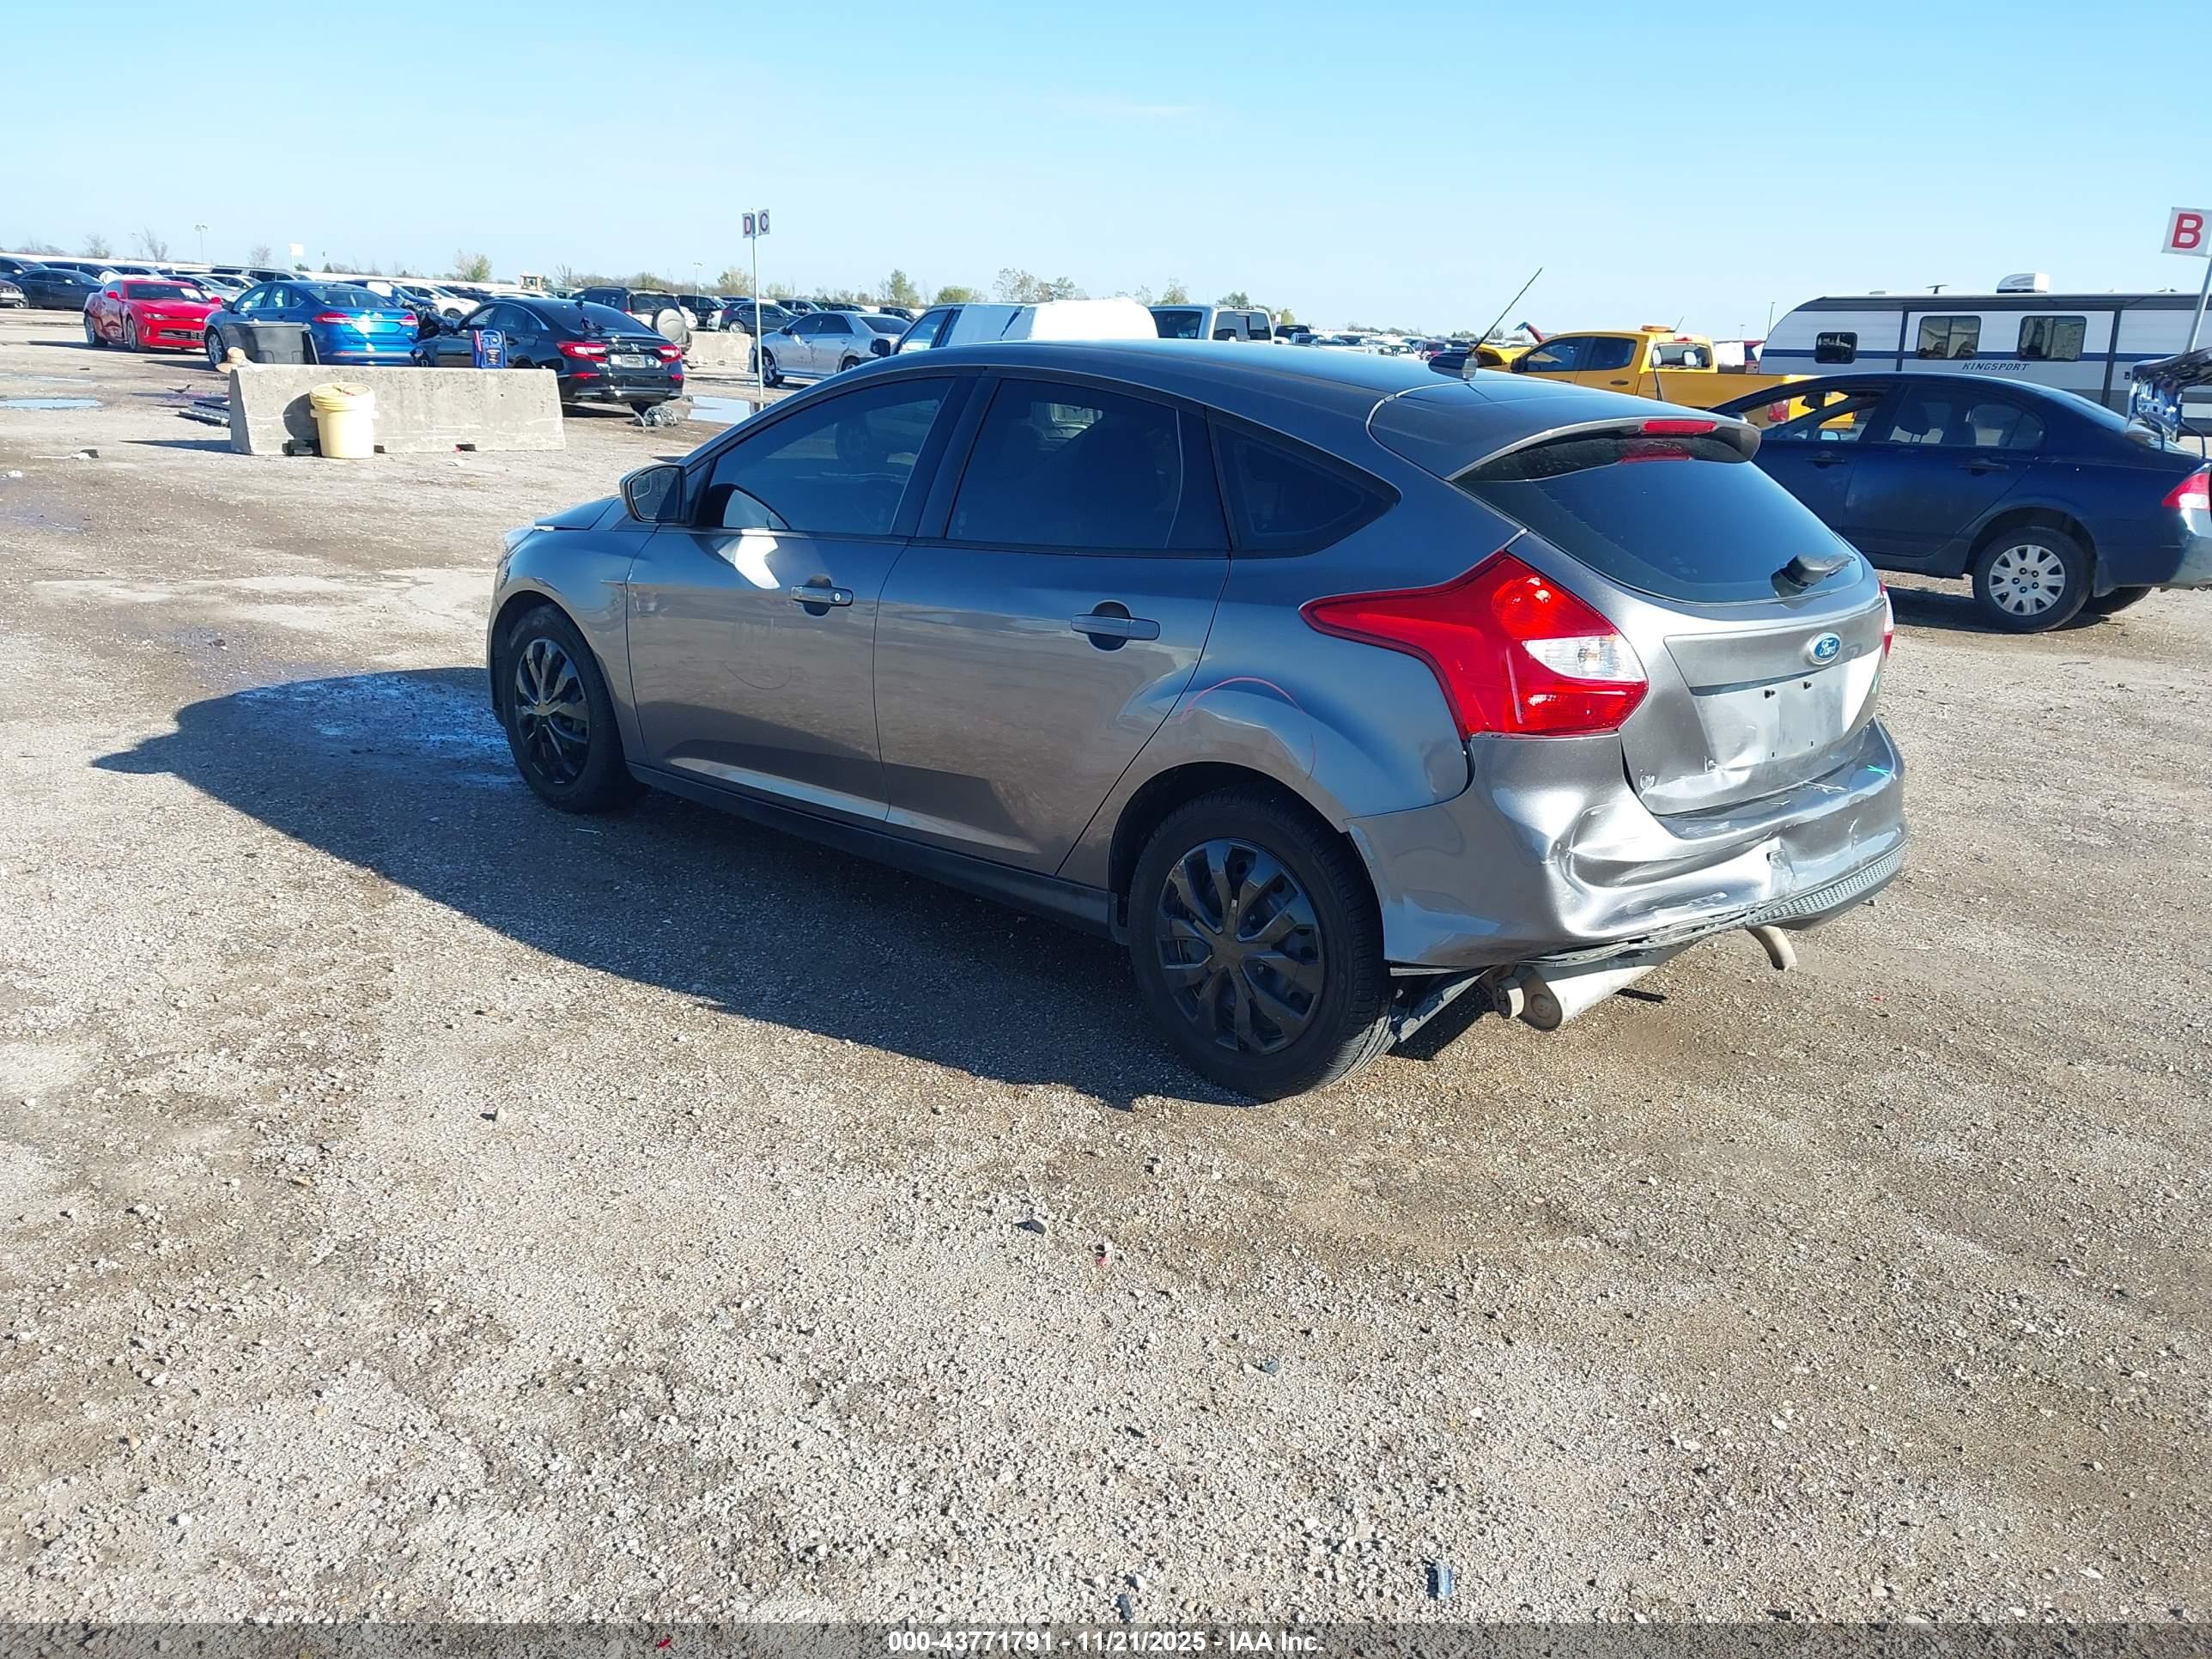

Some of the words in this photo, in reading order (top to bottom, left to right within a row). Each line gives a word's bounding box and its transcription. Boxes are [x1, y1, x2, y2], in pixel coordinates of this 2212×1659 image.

[744, 216, 752, 234] D
[760, 212, 769, 232] C
[2172, 212, 2203, 249] B
[1962, 362, 2030, 371] KINGSPORT
